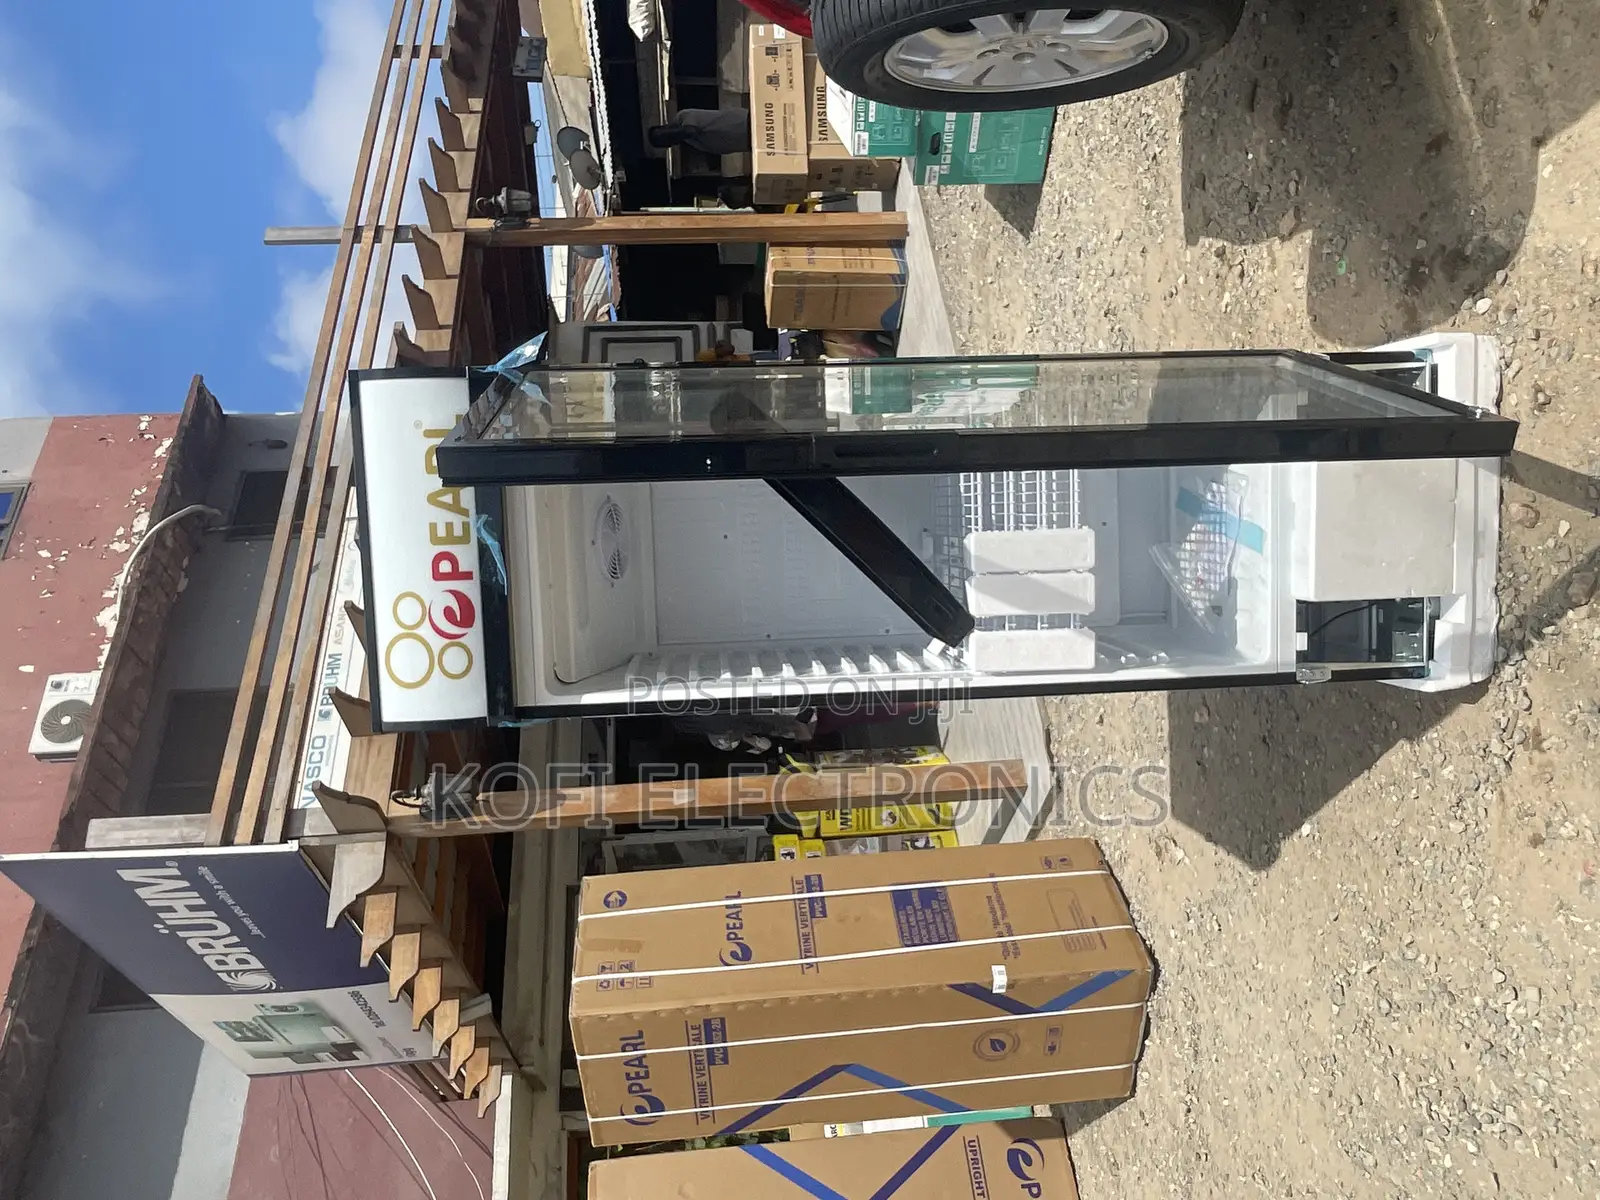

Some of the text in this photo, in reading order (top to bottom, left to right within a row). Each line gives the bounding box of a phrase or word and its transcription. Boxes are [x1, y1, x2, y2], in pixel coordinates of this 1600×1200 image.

[764, 102, 776, 157] SAMSUNG
[801, 931, 814, 969] VTRINE
[695, 1080, 710, 1120] VTRINE
[966, 1139, 986, 1199] UPRIGHT
